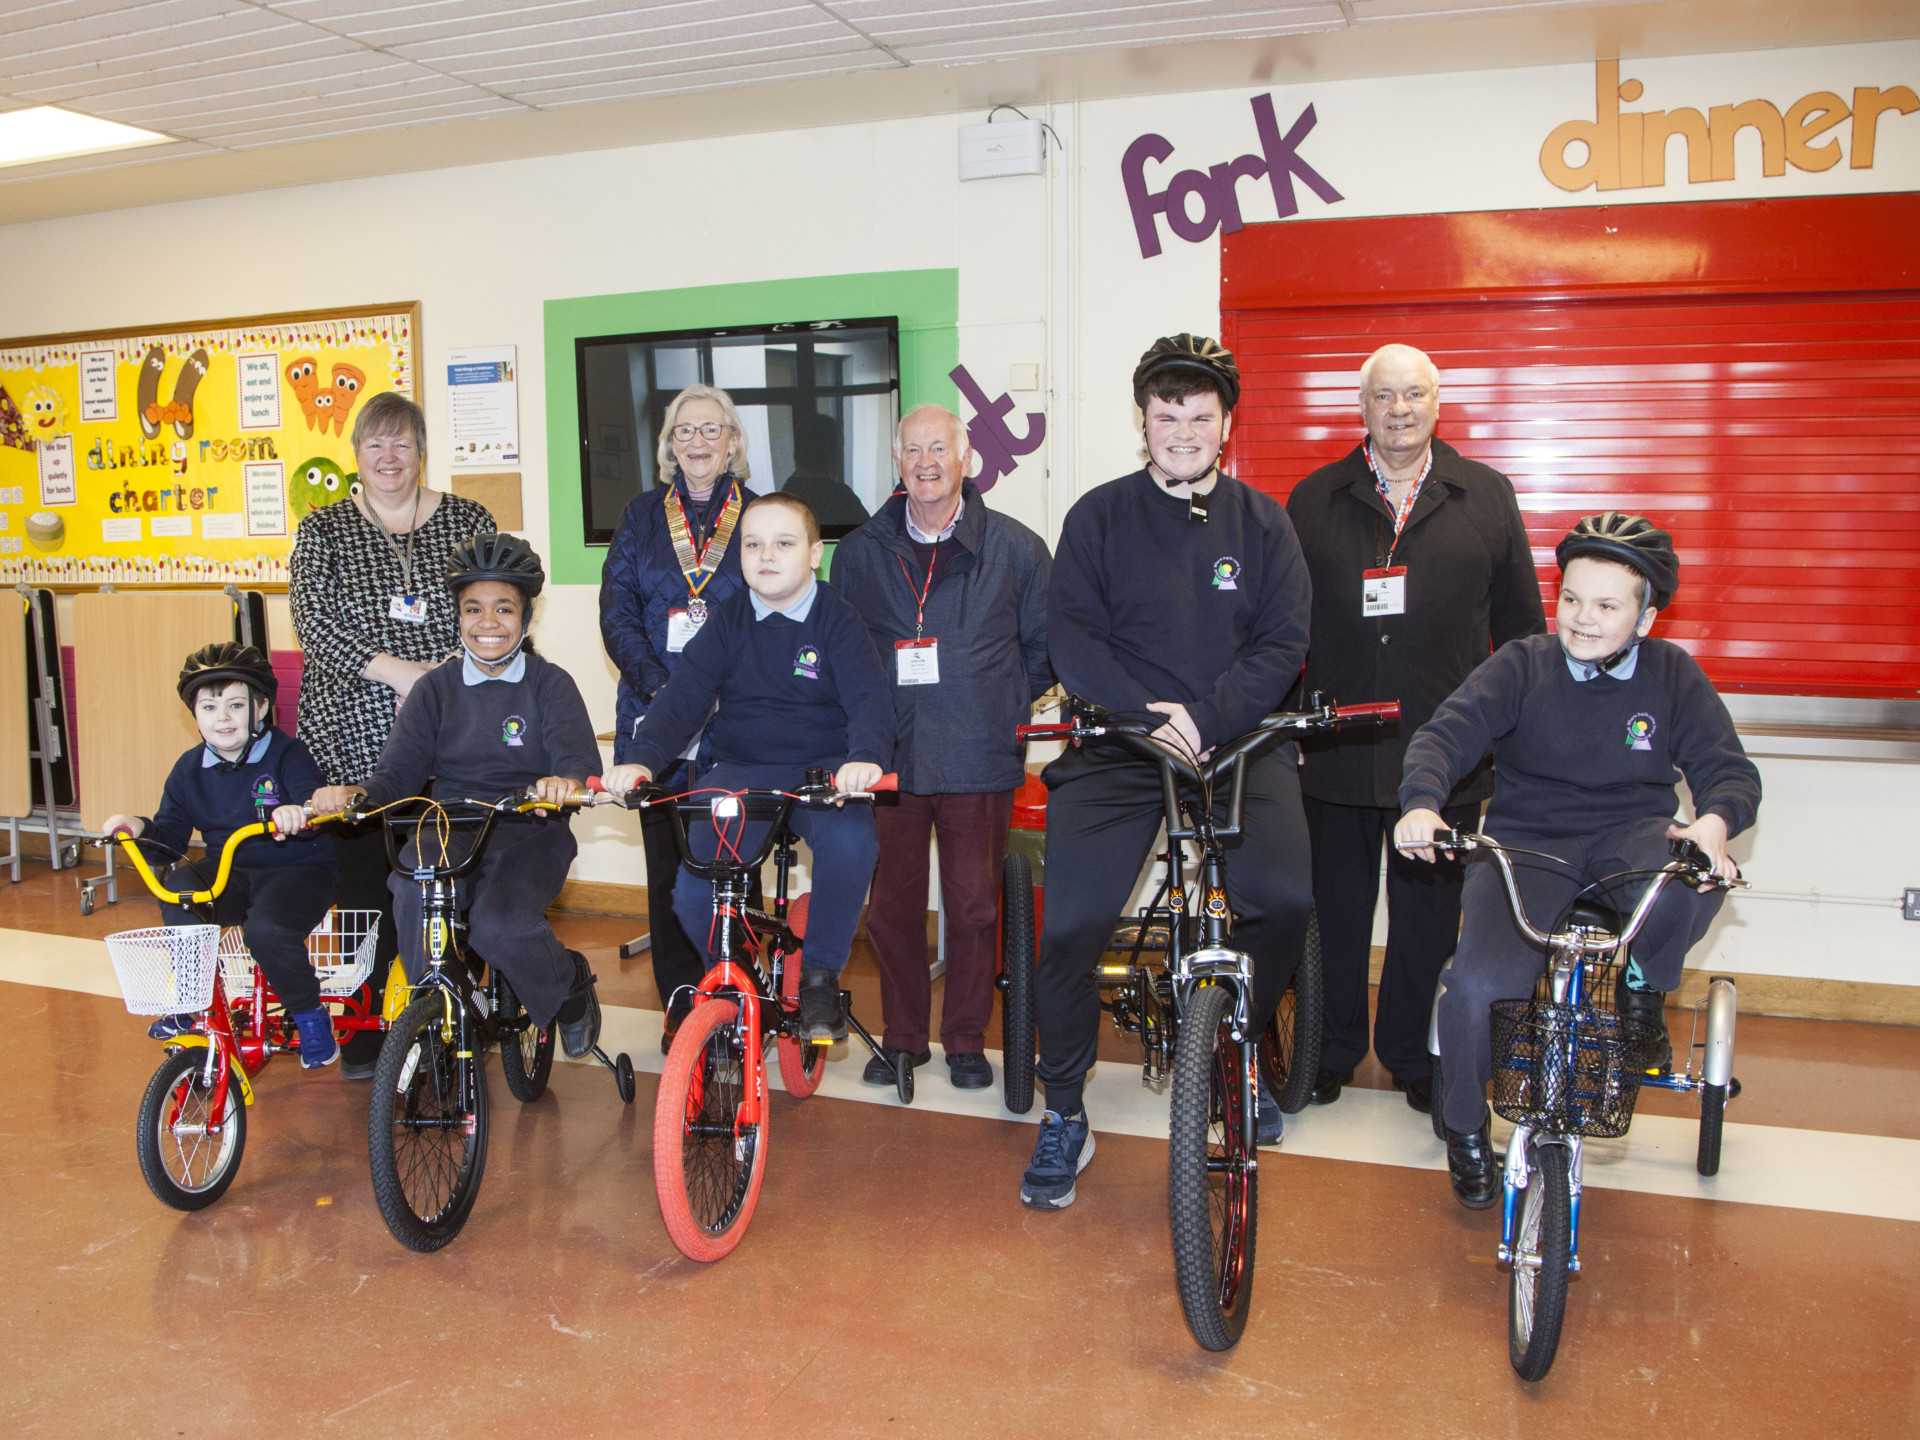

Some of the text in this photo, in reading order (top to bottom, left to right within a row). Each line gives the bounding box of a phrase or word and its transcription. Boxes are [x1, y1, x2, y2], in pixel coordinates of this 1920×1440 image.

[1539, 59, 1920, 193] dinner
[1121, 92, 1346, 260] fork
[246, 362, 258, 371] We
[246, 377, 271, 387] eat and
[244, 393, 262, 403] enjoy
[251, 408, 270, 417] lunch
[45, 443, 67, 451] We line
[86, 436, 278, 476] dining room
[48, 471, 68, 481] quietly
[56, 485, 71, 494] lunch
[109, 480, 218, 514] charter
